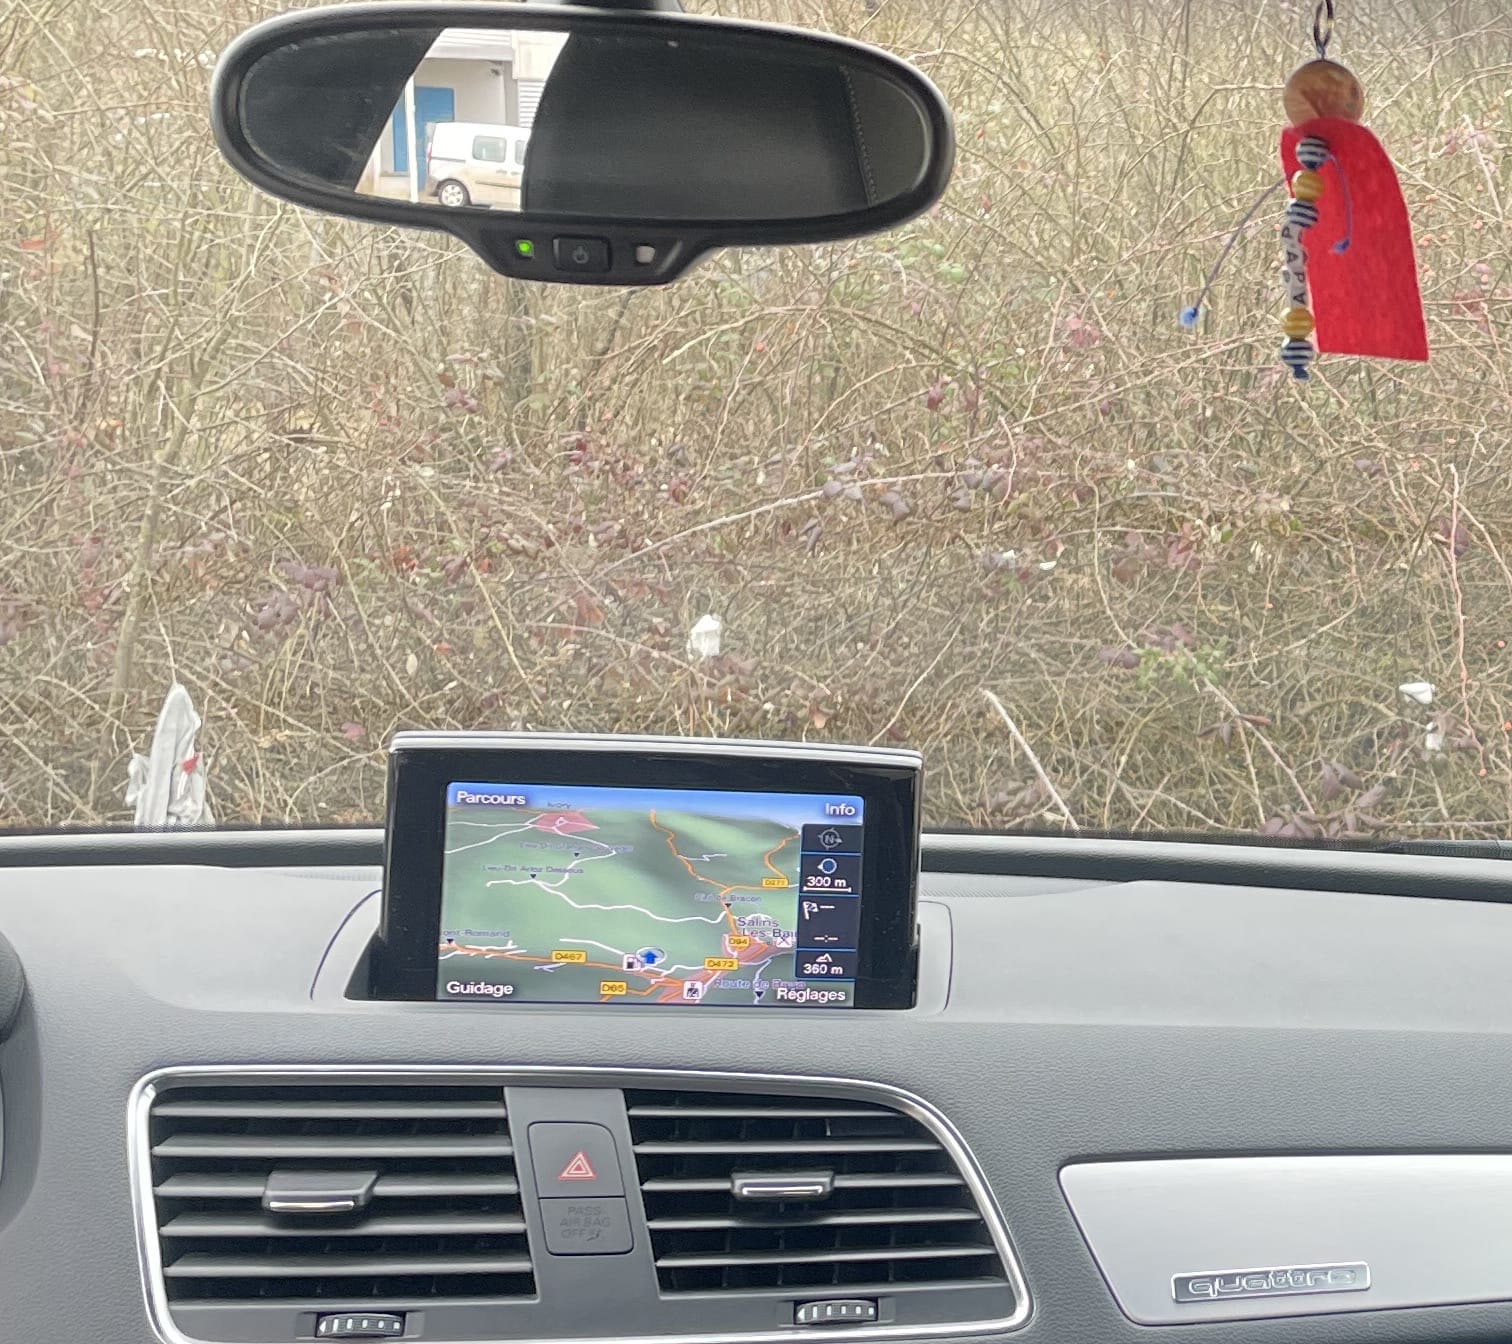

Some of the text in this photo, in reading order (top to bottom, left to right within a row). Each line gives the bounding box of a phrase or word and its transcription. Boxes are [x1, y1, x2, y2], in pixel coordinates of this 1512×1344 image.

[456, 790, 527, 806] Parcours
[824, 802, 857, 817] Info
[806, 876, 847, 888] 300 m
[737, 916, 780, 928] Salins
[554, 952, 583, 962] D467
[707, 959, 736, 968] D472
[803, 964, 844, 975] 360 m
[446, 980, 514, 998] Guidage
[601, 982, 625, 993] D65
[776, 986, 846, 1003] Réglages
[567, 1206, 602, 1216] PASS
[560, 1228, 587, 1240] OFF
[1188, 1269, 1357, 1298] quattro
